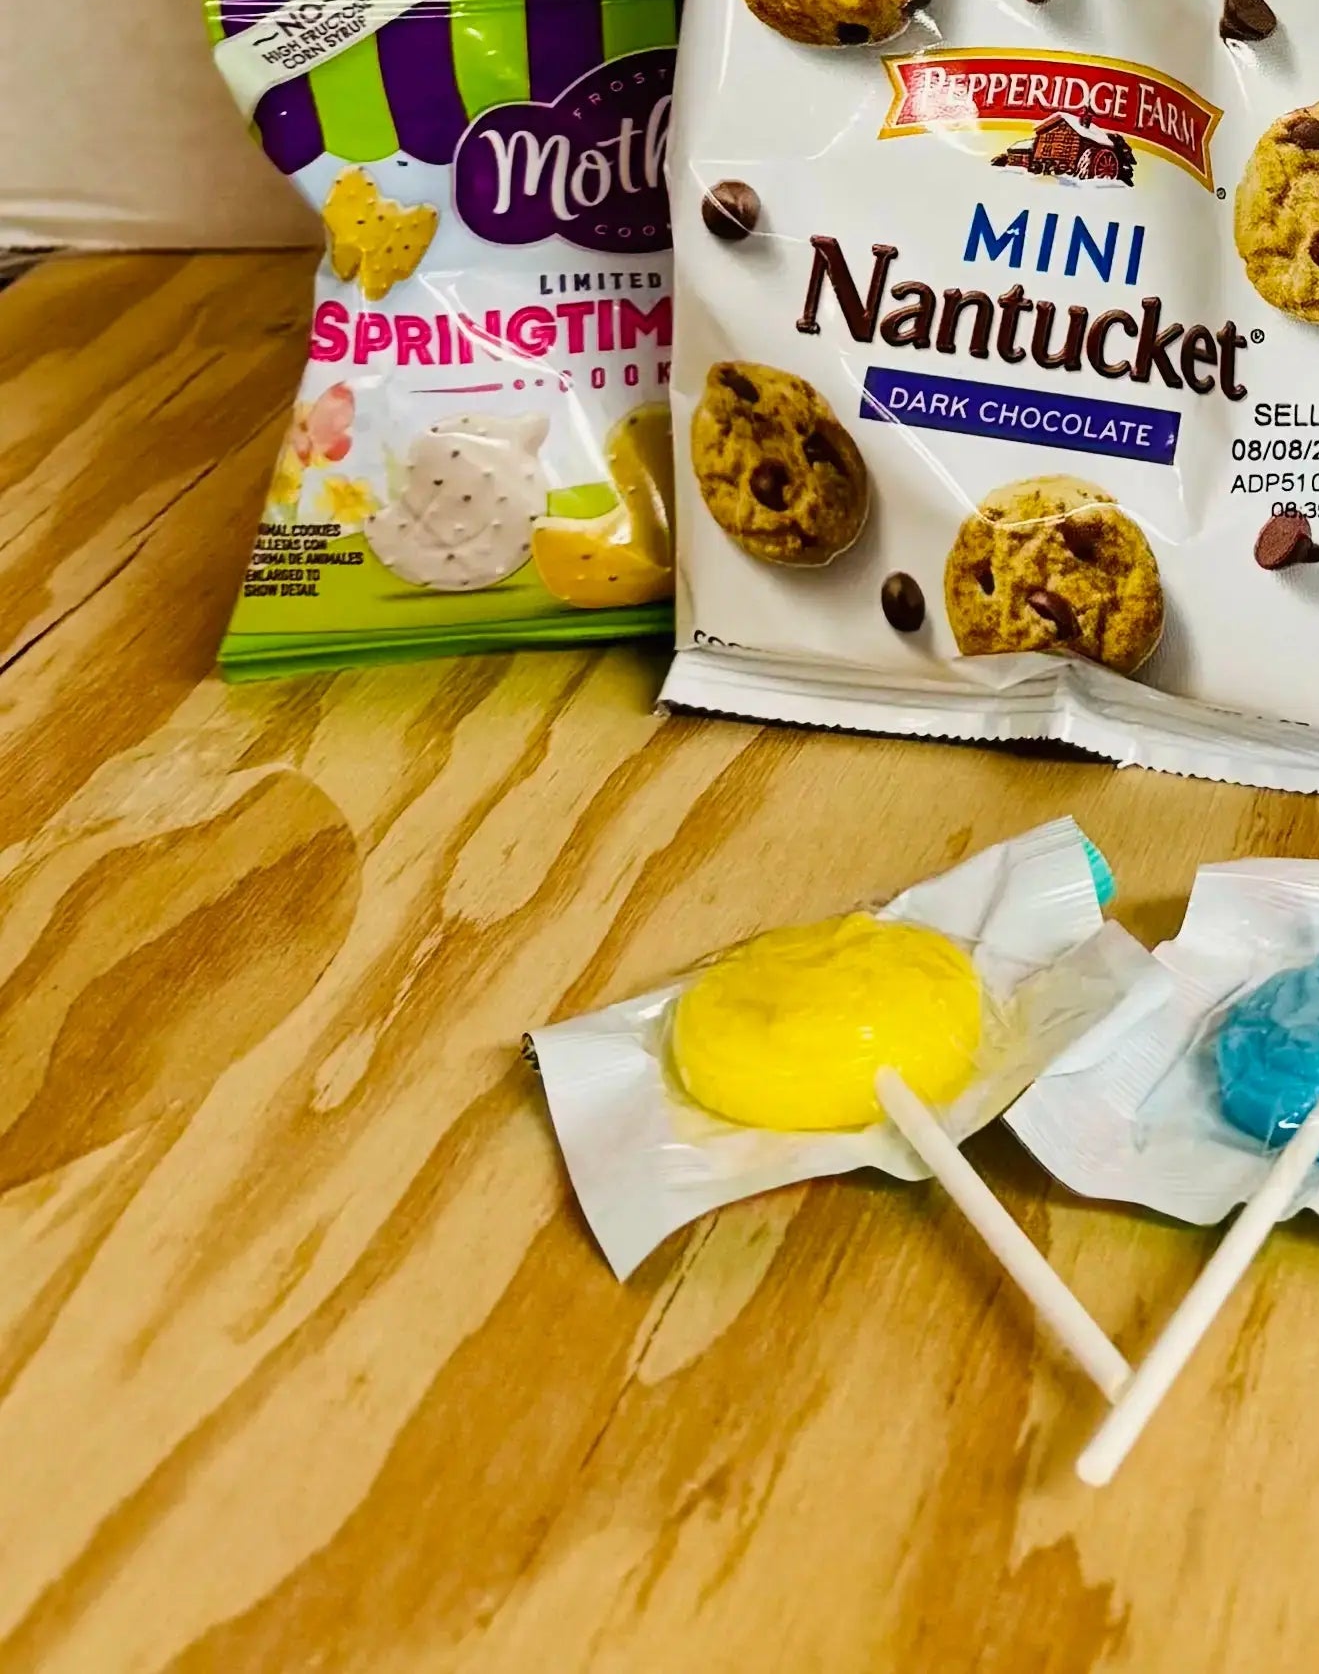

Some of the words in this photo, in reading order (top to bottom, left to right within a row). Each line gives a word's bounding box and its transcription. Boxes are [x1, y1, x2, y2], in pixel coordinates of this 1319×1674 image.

[276, 3, 327, 37] NO
[261, 40, 302, 64] HIGH
[282, 44, 327, 70] CORN
[920, 65, 1130, 120] PEPPERIDGE
[1137, 83, 1197, 152] FARM
[594, 224, 672, 238] COO
[963, 202, 1146, 286] MINI
[540, 272, 662, 295] LIMITED
[795, 234, 1248, 402] Nantucket
[888, 386, 971, 421] DARK
[979, 400, 1154, 448] CHOCOLATE
[305, 568, 320, 582] TO
